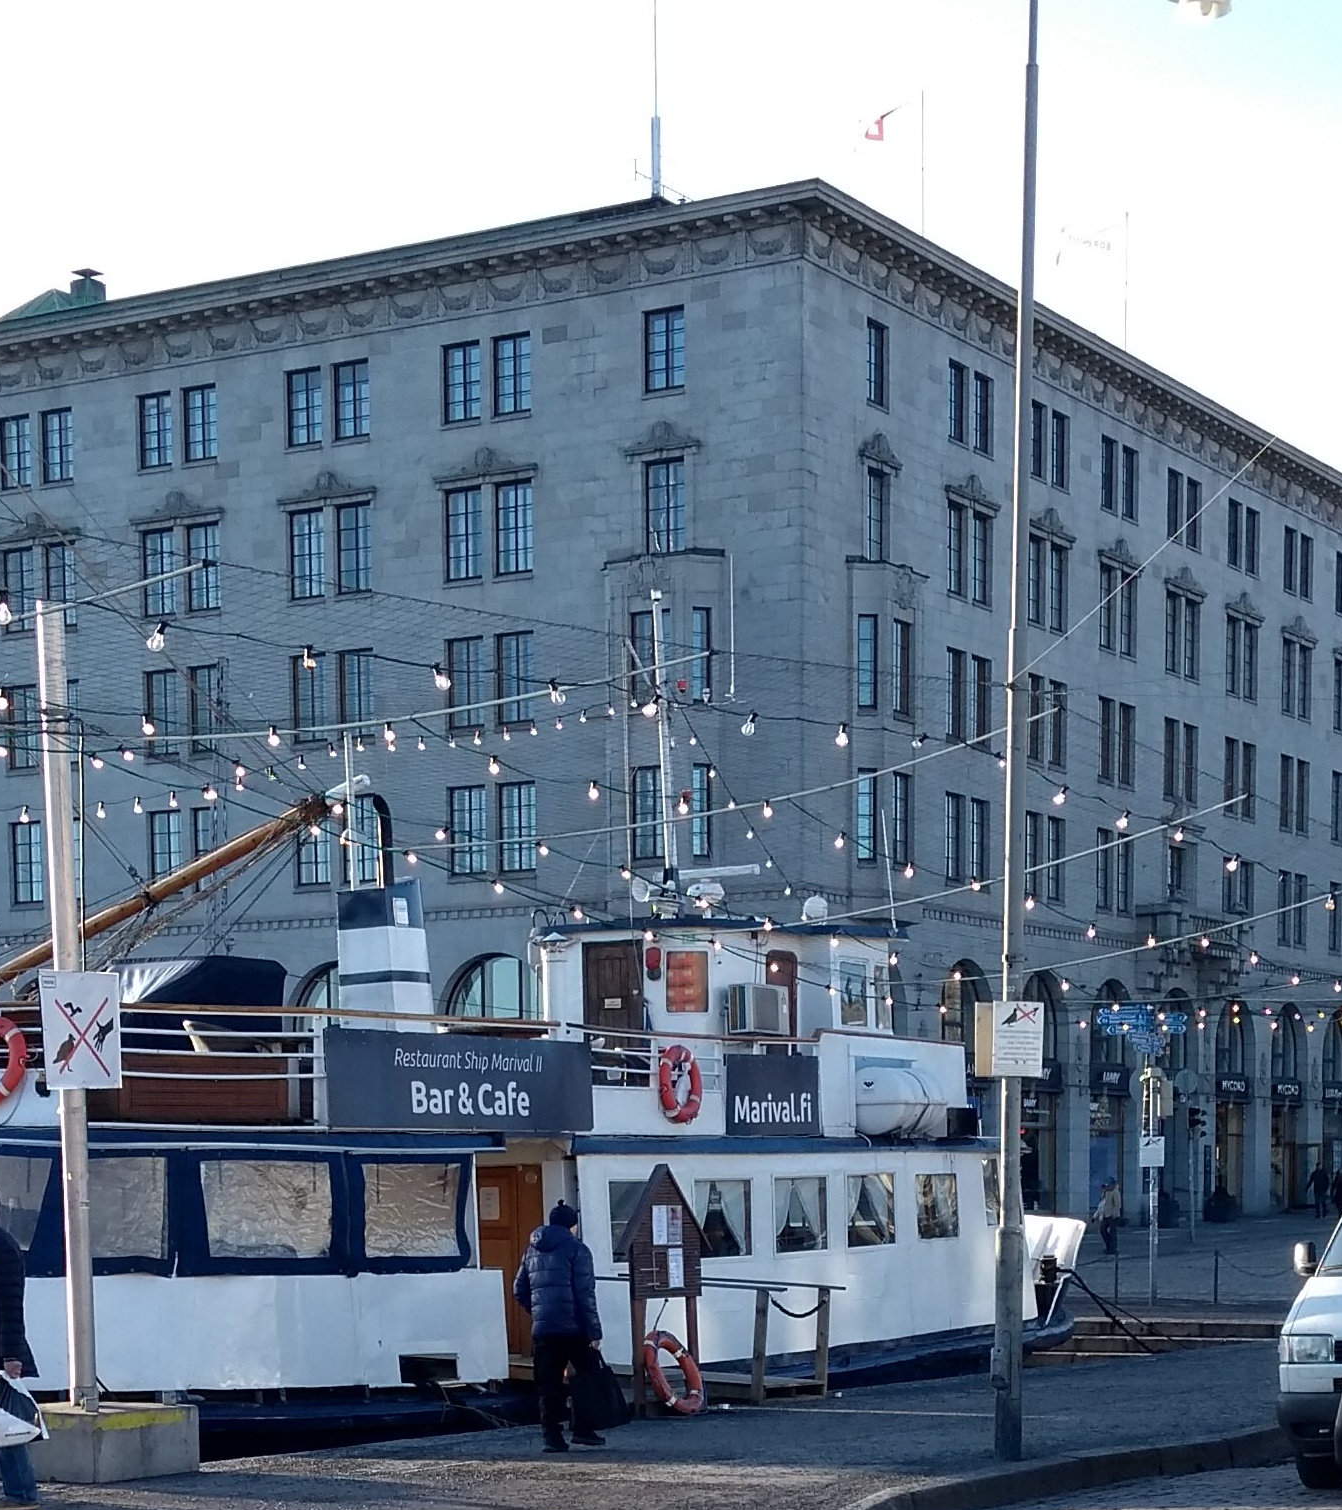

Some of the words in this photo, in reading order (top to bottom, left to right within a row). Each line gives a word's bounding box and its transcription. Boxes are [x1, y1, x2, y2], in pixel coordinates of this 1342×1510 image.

[394, 1048, 462, 1069] Restaurant
[464, 1051, 489, 1075] Ship
[491, 1053, 534, 1073] Marival
[410, 1080, 454, 1115] Bar
[457, 1081, 475, 1115] &
[477, 1081, 530, 1117] Cafe
[734, 1092, 812, 1124] Marival.fi
